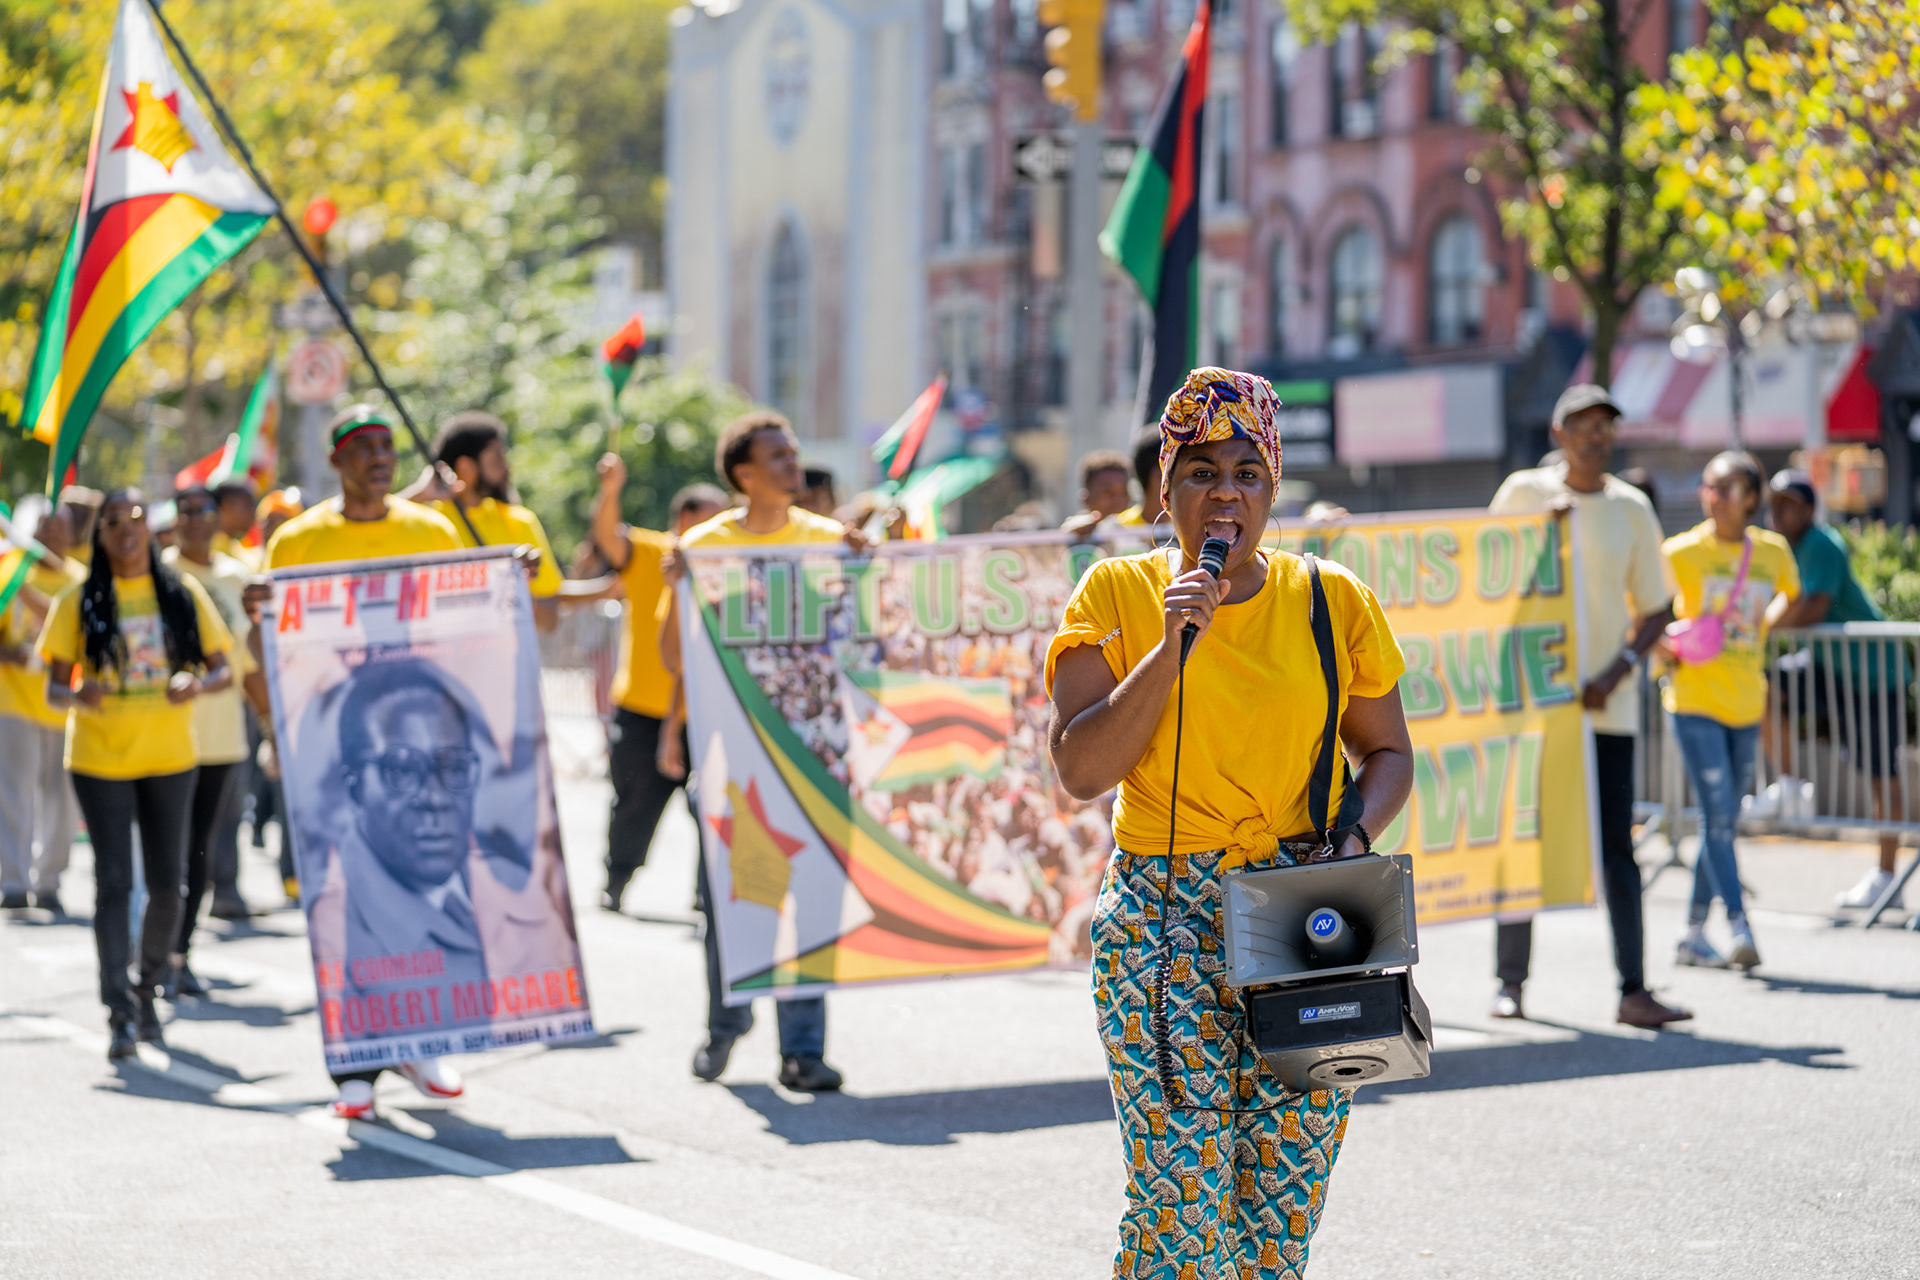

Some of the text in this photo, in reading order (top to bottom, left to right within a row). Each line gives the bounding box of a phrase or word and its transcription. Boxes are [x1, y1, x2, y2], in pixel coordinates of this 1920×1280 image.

[722, 558, 890, 645] LIFT
[1473, 520, 1564, 600] ON
[1315, 919, 1333, 930] AV
[353, 948, 446, 986] COMRADE
[324, 967, 583, 1036] ROBERT MUGABE
